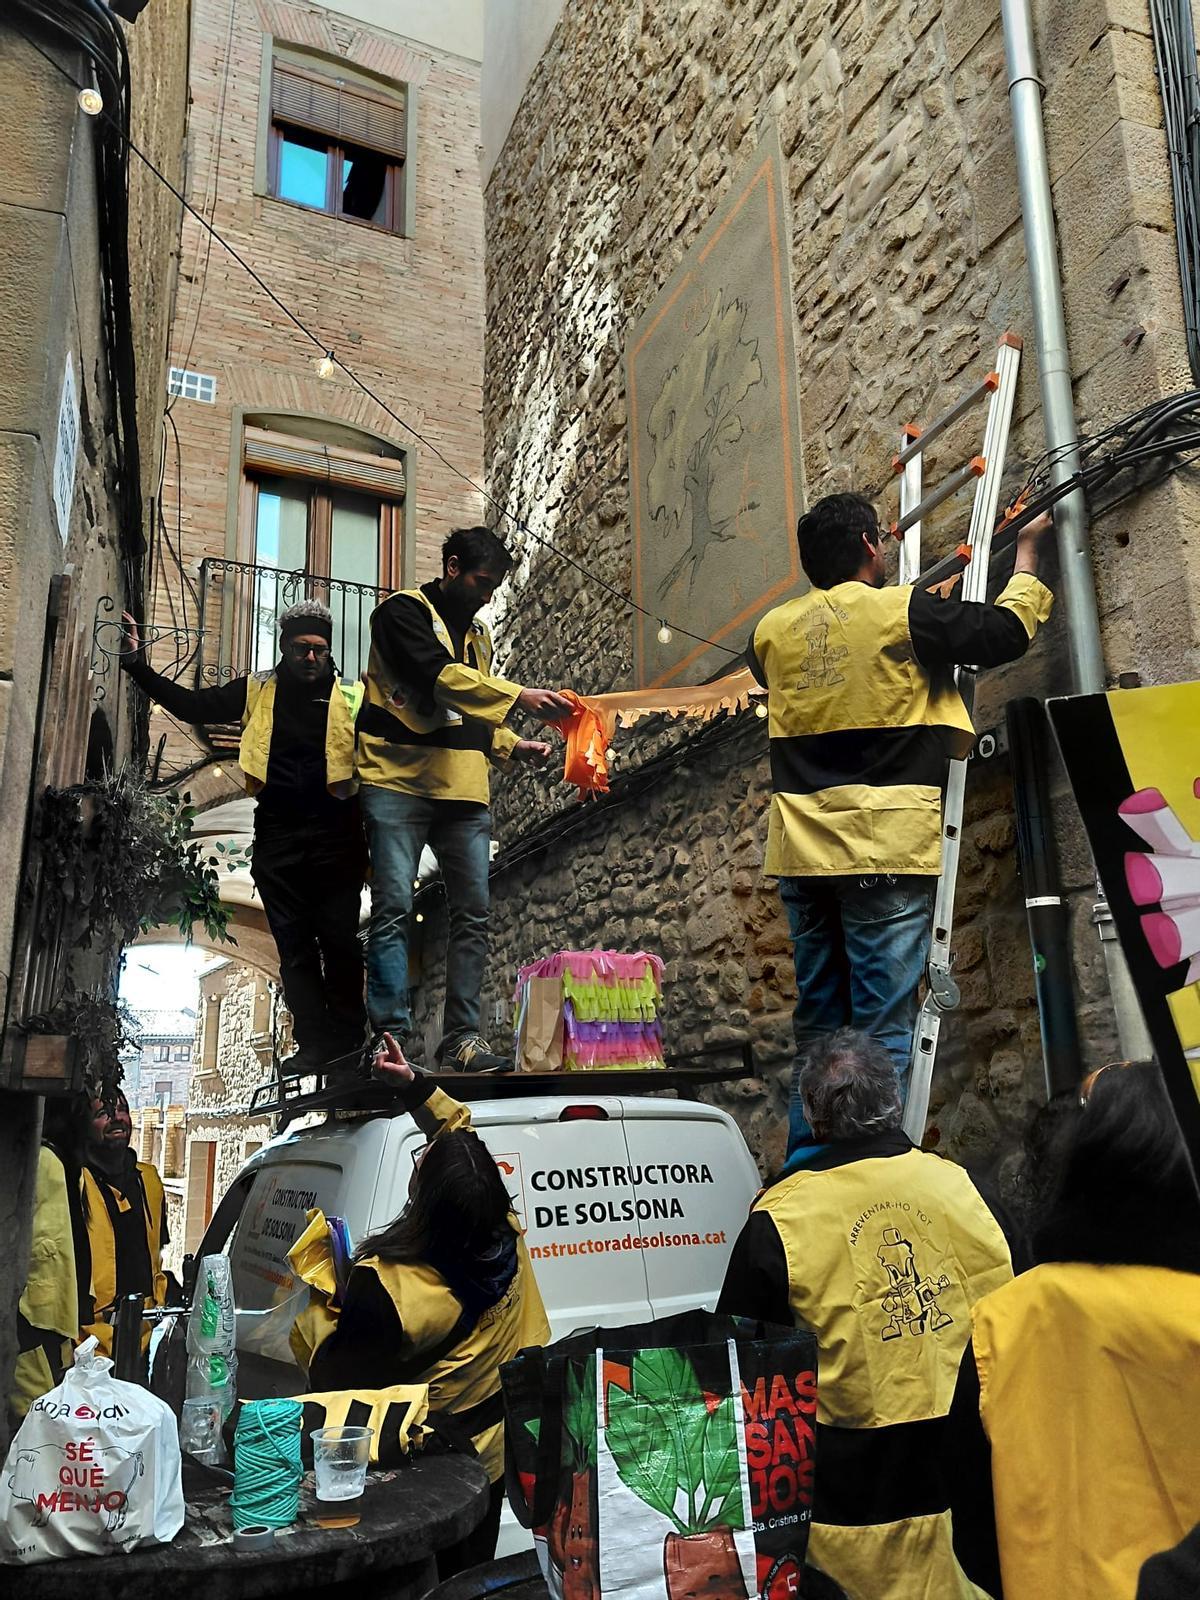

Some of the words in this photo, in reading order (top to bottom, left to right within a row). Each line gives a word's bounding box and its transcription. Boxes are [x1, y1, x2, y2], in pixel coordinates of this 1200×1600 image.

[531, 1164, 714, 1191] CONSTRUCTORA
[534, 1205, 570, 1228] DE
[575, 1198, 685, 1225] SOLSONA
[850, 1201, 911, 1247] ARREVENTAR-HO
[916, 1209, 933, 1226] TOT
[530, 1230, 727, 1259] nstructoradesolsona.cat
[740, 1370, 817, 1421] MAS
[65, 1436, 95, 1462] SÉ
[59, 1463, 105, 1488] QUÈ
[35, 1491, 127, 1513] MENJO
[752, 1521, 767, 1533] Sta.
[768, 1513, 798, 1529] Cristina
